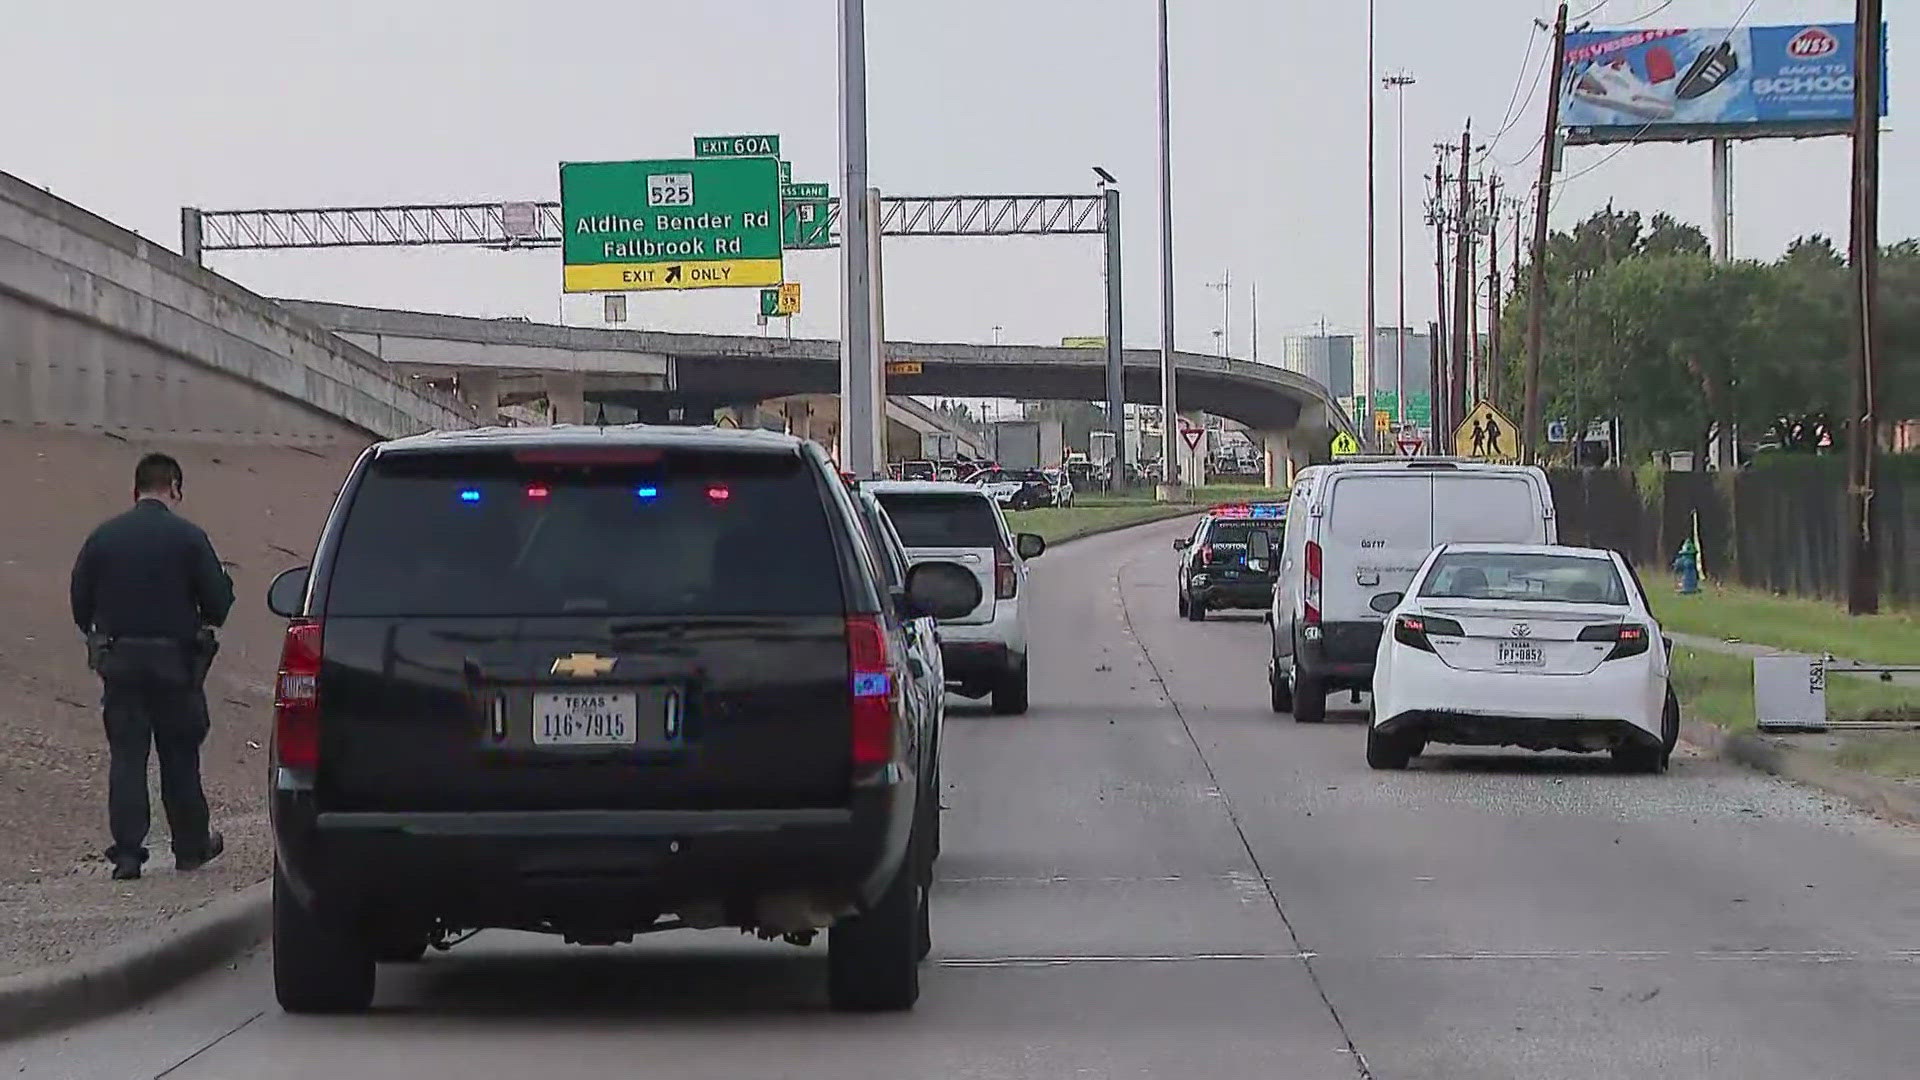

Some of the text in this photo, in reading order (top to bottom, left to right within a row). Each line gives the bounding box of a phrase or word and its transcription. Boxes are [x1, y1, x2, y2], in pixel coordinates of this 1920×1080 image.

[1752, 76, 1855, 95] SCHOO
[702, 138, 771, 154] EXIT 60A
[651, 186, 690, 204] 525
[576, 211, 769, 234] Aldine Bender Rd
[603, 236, 741, 258] Fallbrook Rd
[622, 267, 731, 282] EXIT ONLY
[565, 697, 605, 708] TEXAS
